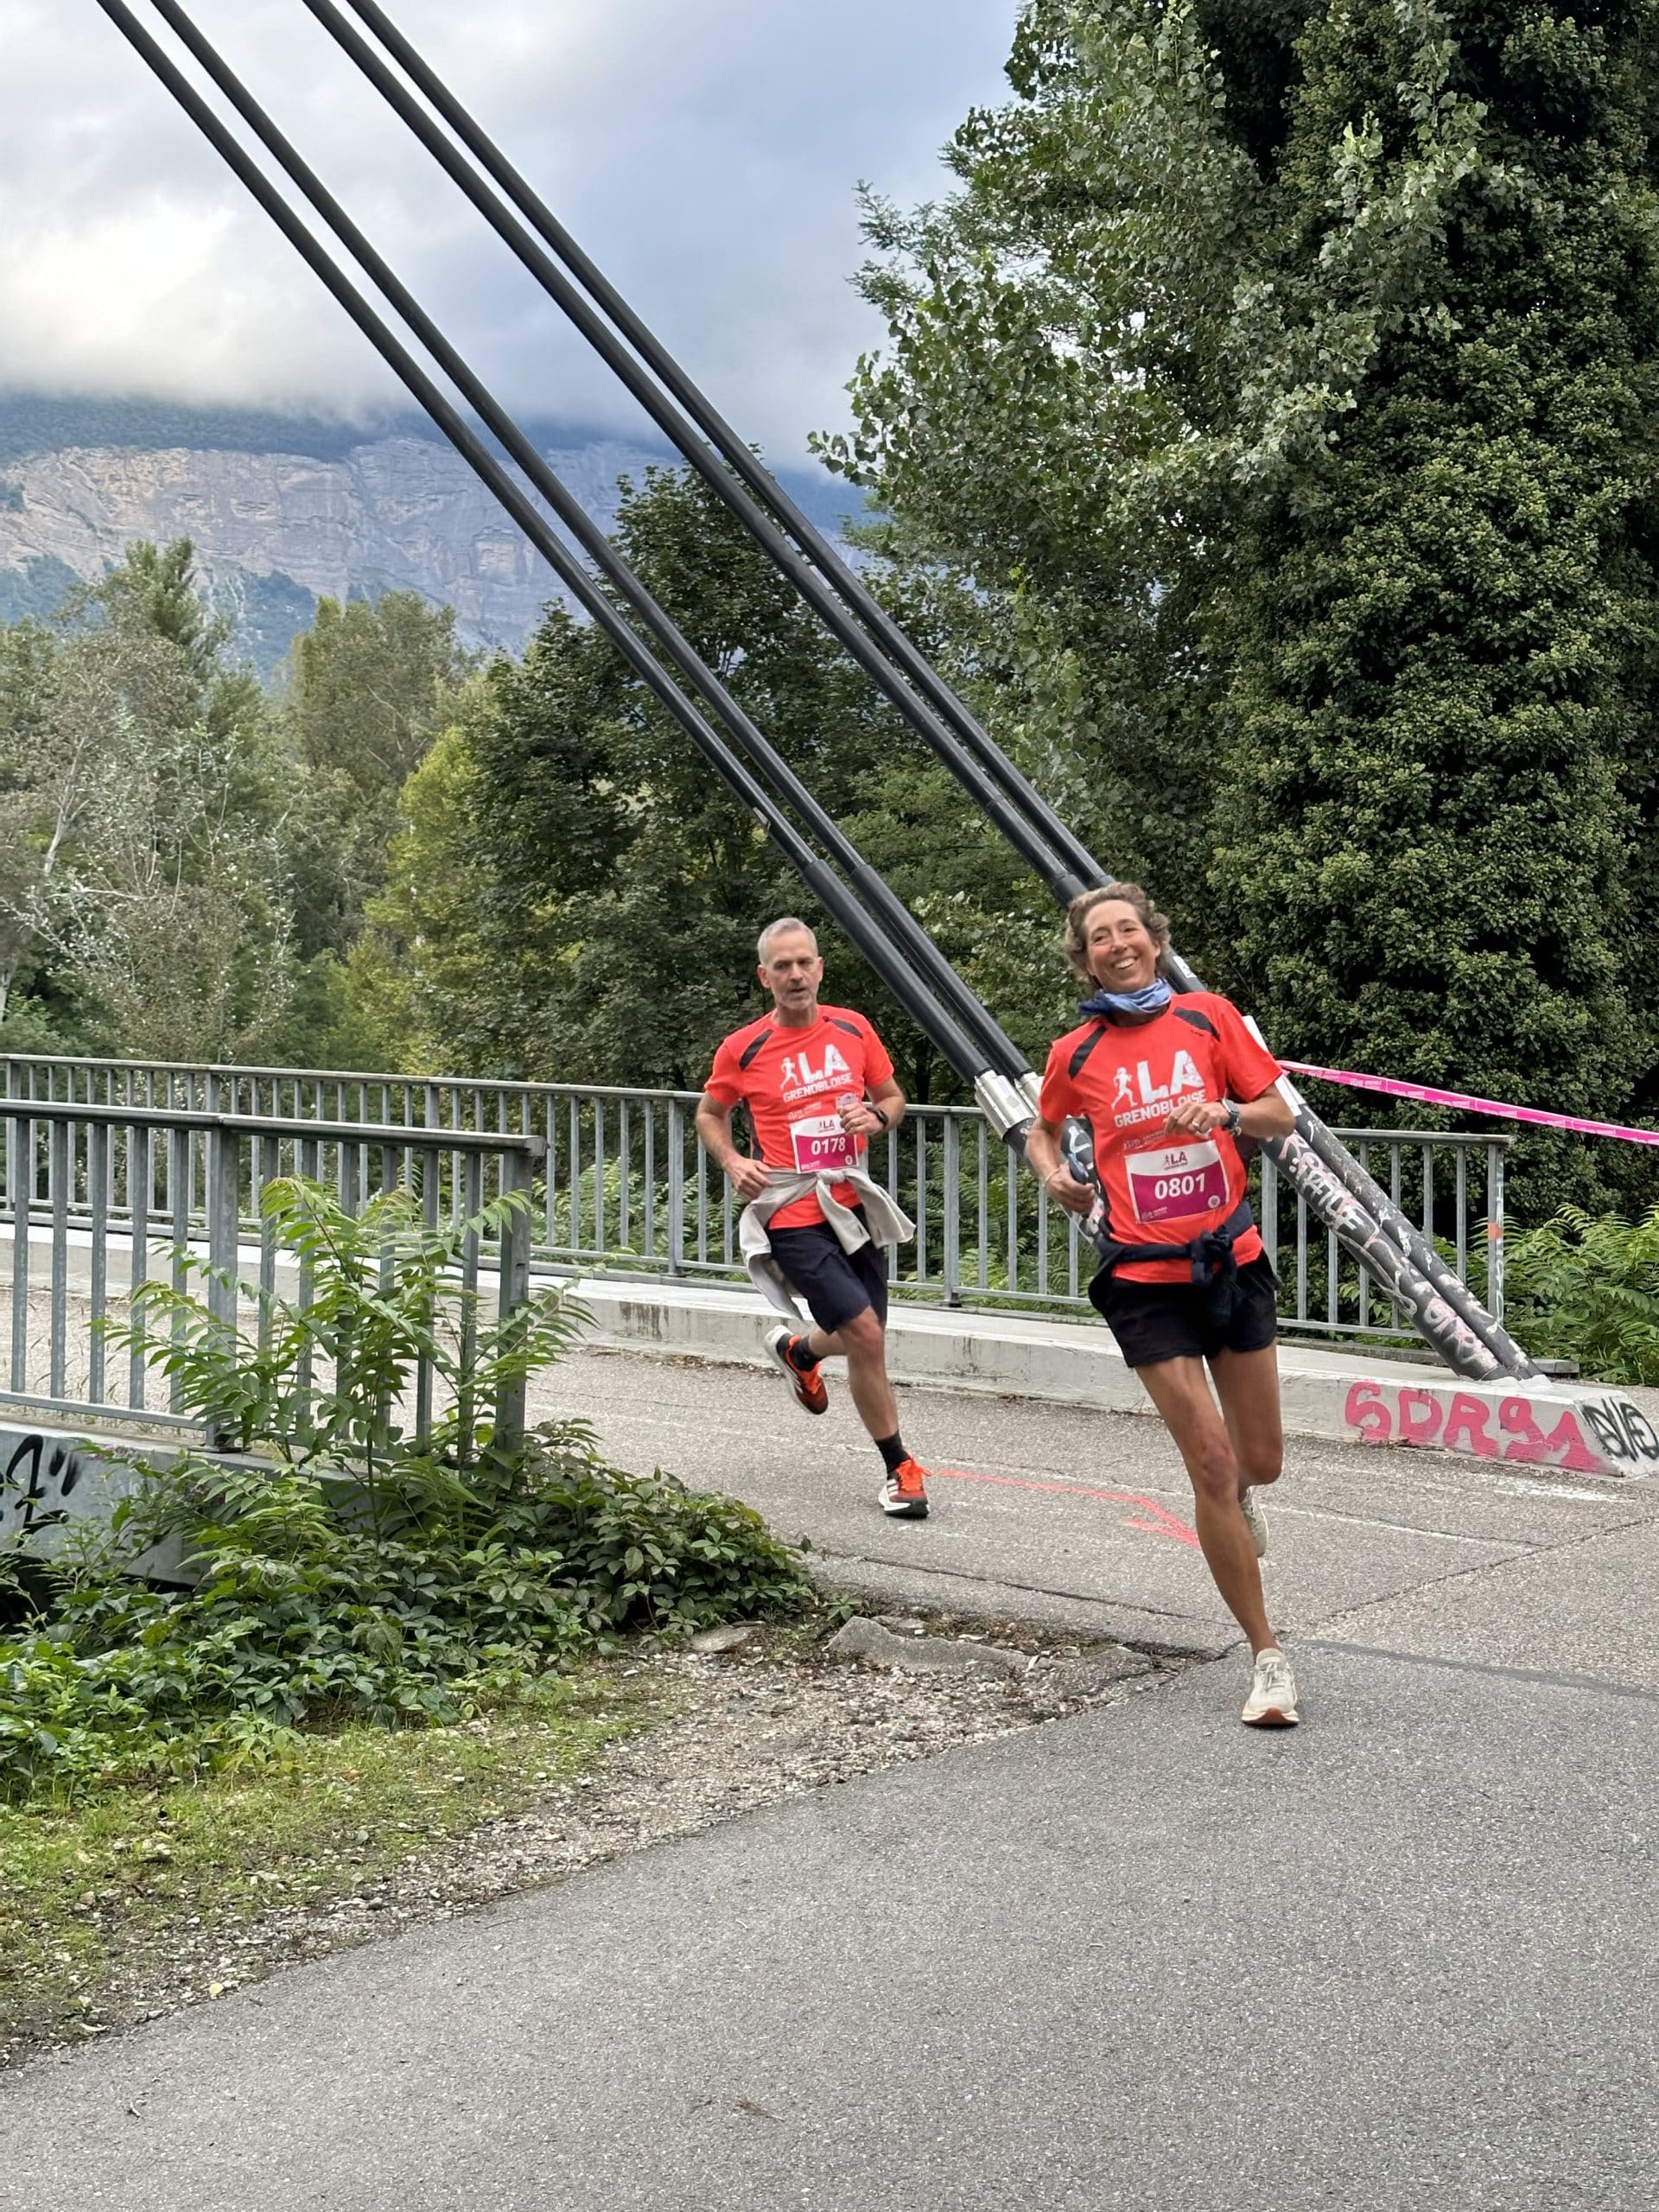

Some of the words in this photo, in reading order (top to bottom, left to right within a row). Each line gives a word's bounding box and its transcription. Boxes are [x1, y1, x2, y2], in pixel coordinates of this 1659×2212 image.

[798, 1044, 850, 1084] LA
[1136, 1049, 1205, 1105] LA
[782, 1072, 854, 1103] GRENOBLOISE
[810, 1136, 846, 1156] 0178
[1170, 1150, 1188, 1165] LA
[1154, 1173, 1205, 1200] 0801
